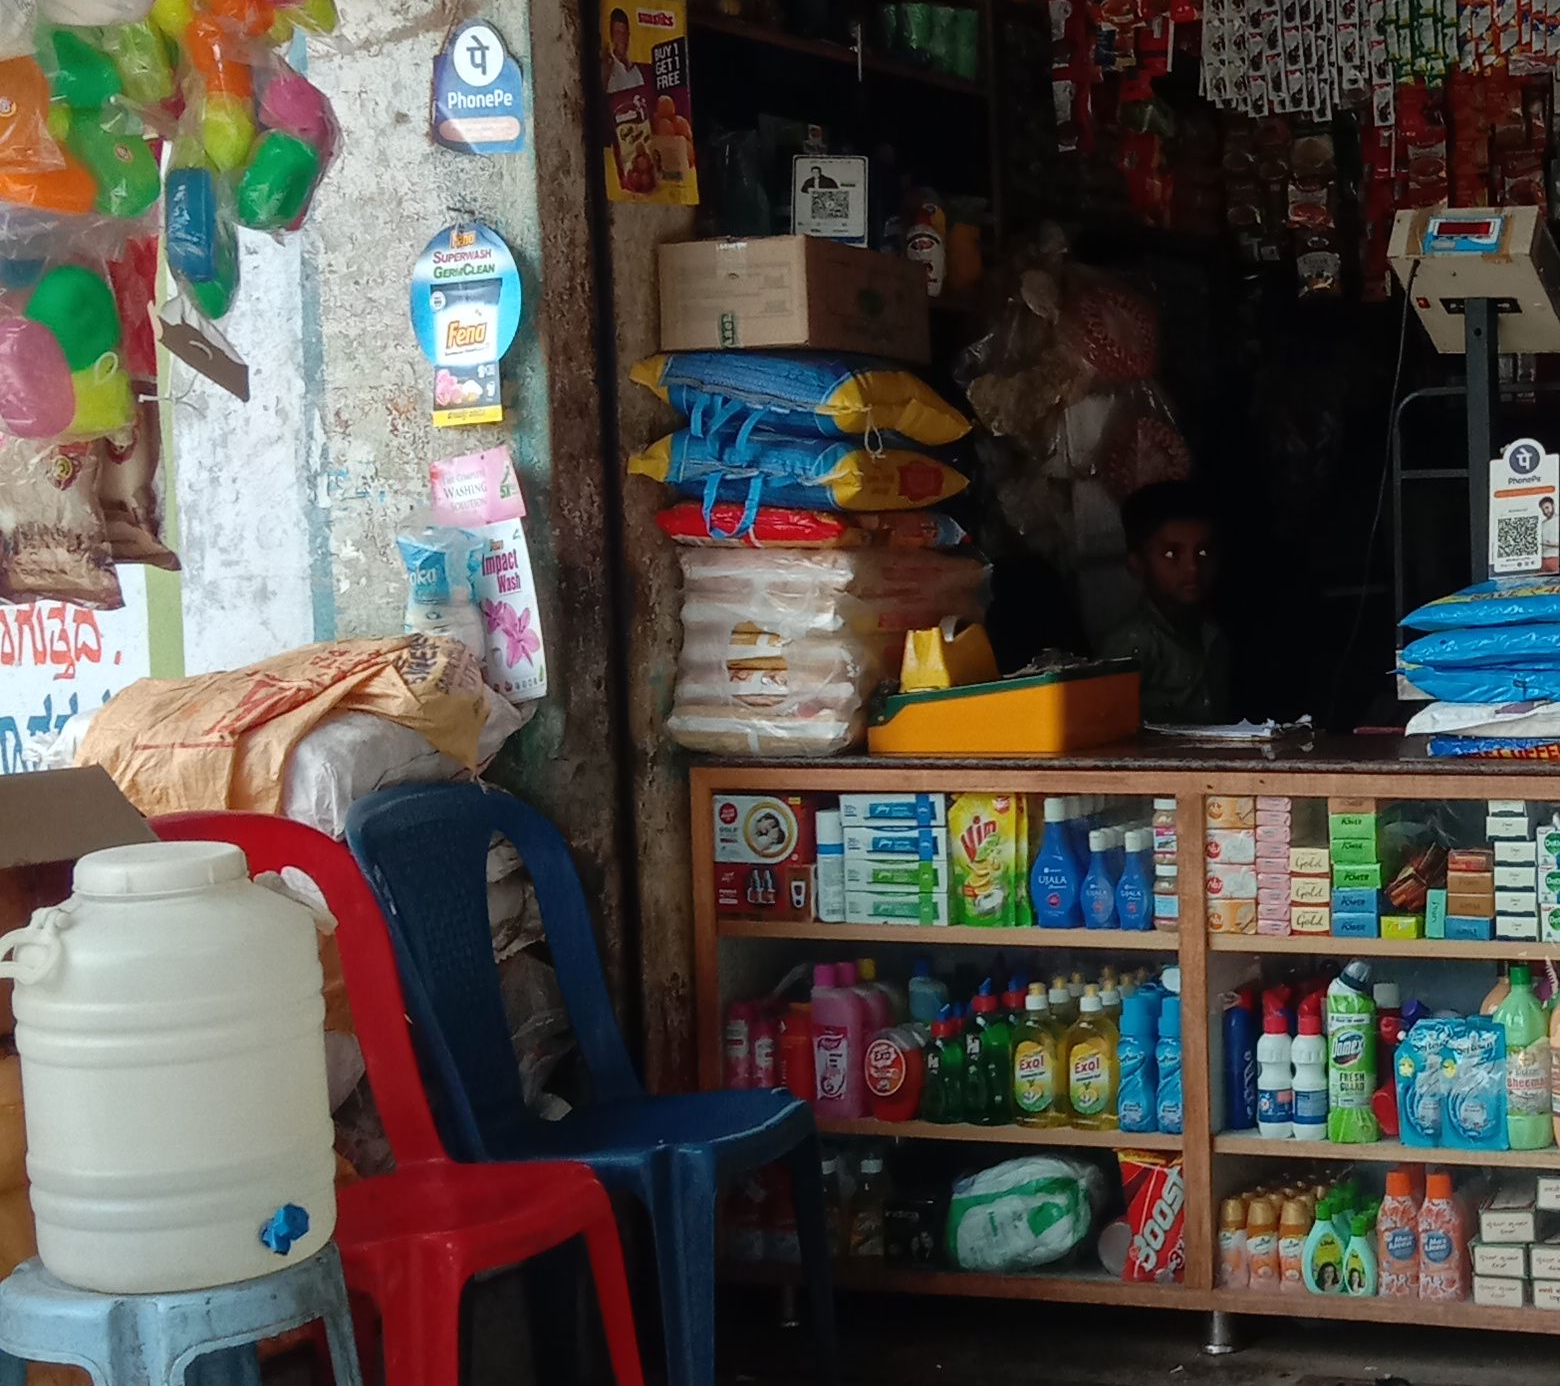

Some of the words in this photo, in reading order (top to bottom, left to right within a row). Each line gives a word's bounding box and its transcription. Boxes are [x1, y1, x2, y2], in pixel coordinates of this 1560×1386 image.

[654, 44, 672, 62] BUY
[655, 58, 673, 76] GET
[656, 71, 681, 90] FREE
[447, 89, 513, 110] PhonePe
[446, 320, 487, 350] Fena
[443, 480, 488, 500] WASHING
[1508, 476, 1541, 485] PhonePe
[481, 548, 518, 577] Impact
[496, 572, 521, 593] Wash
[1037, 874, 1068, 886] UJALA
[1340, 1071, 1365, 1083] FRESH
